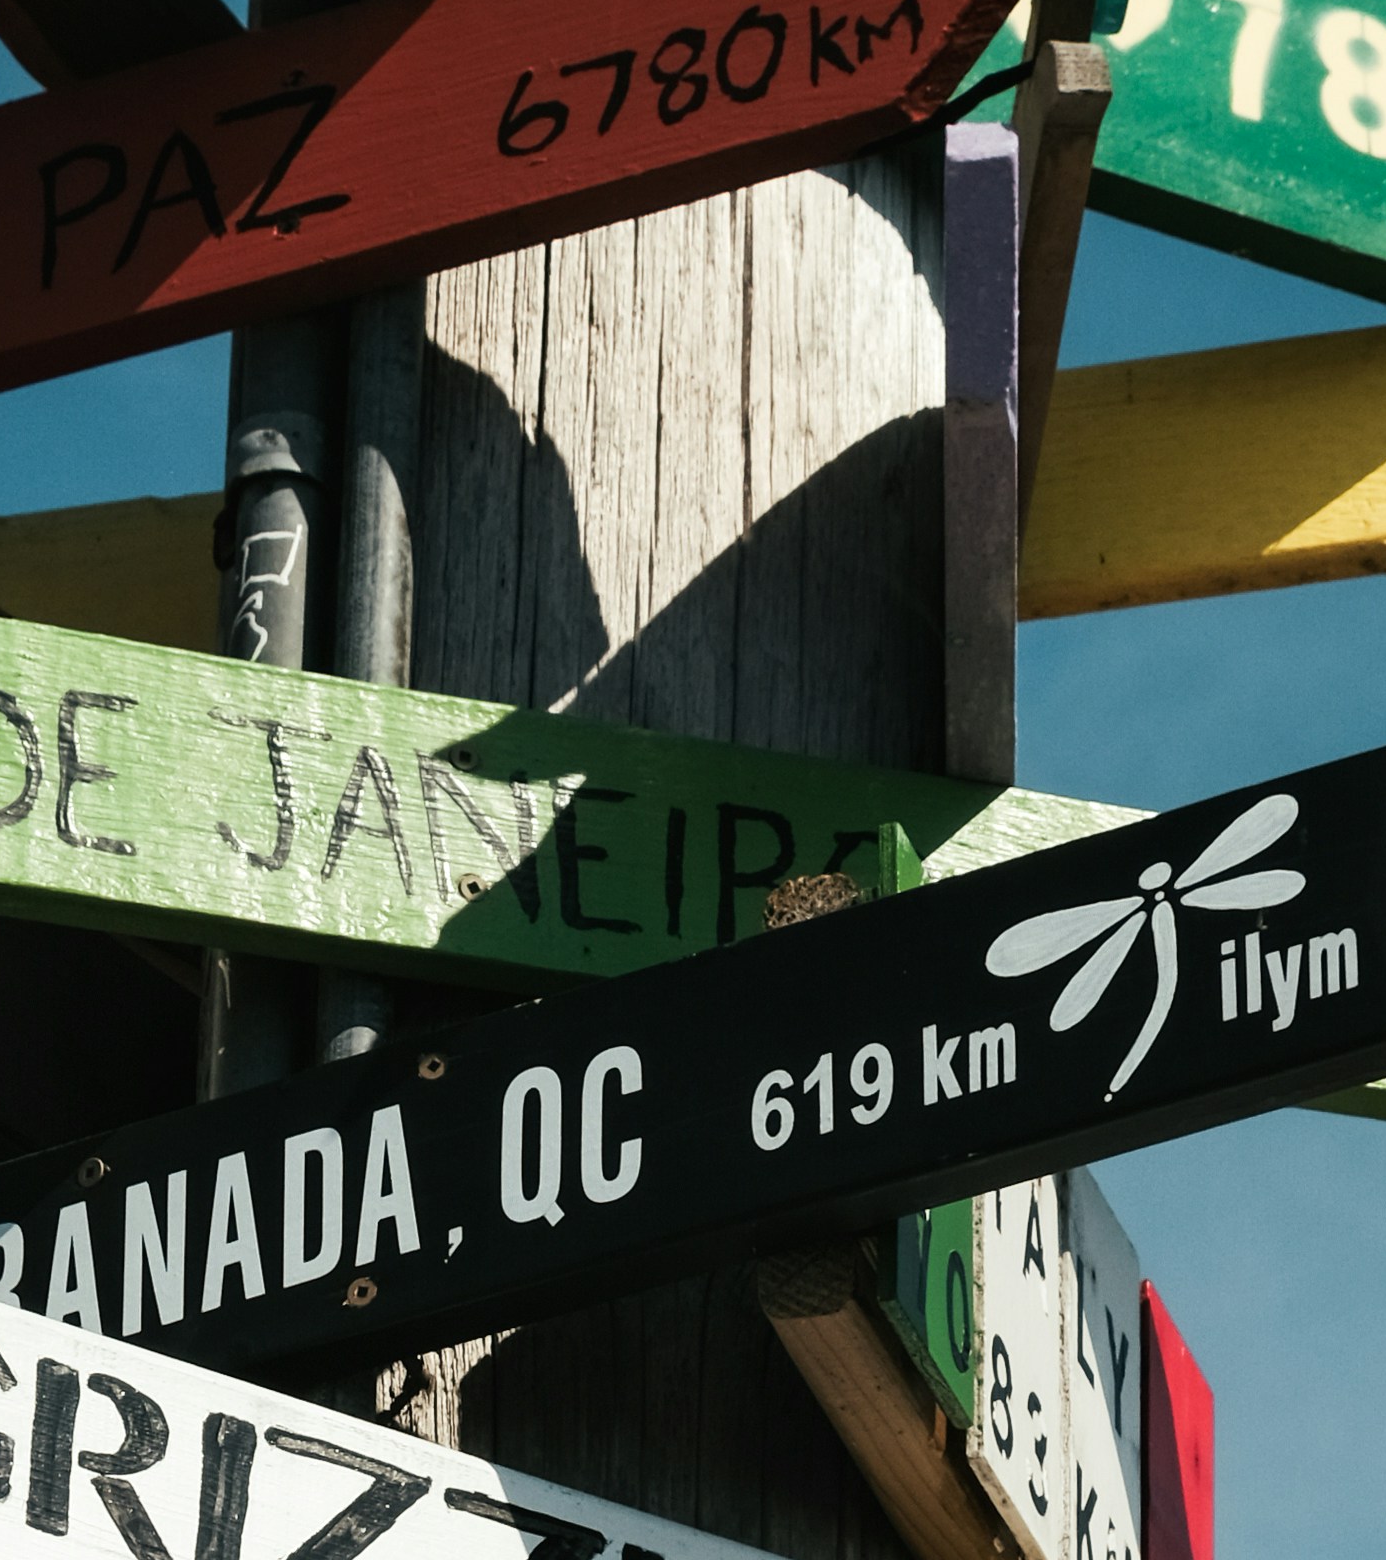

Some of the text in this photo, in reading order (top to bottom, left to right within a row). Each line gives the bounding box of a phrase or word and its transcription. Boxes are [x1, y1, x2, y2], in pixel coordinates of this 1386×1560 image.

[39, 81, 351, 292] PAZ
[496, 3, 787, 158] 6780
[1218, 923, 1360, 1032] ilym
[499, 1044, 645, 1229] QC
[750, 1042, 895, 1153] 619
[921, 1017, 1017, 1108] km
